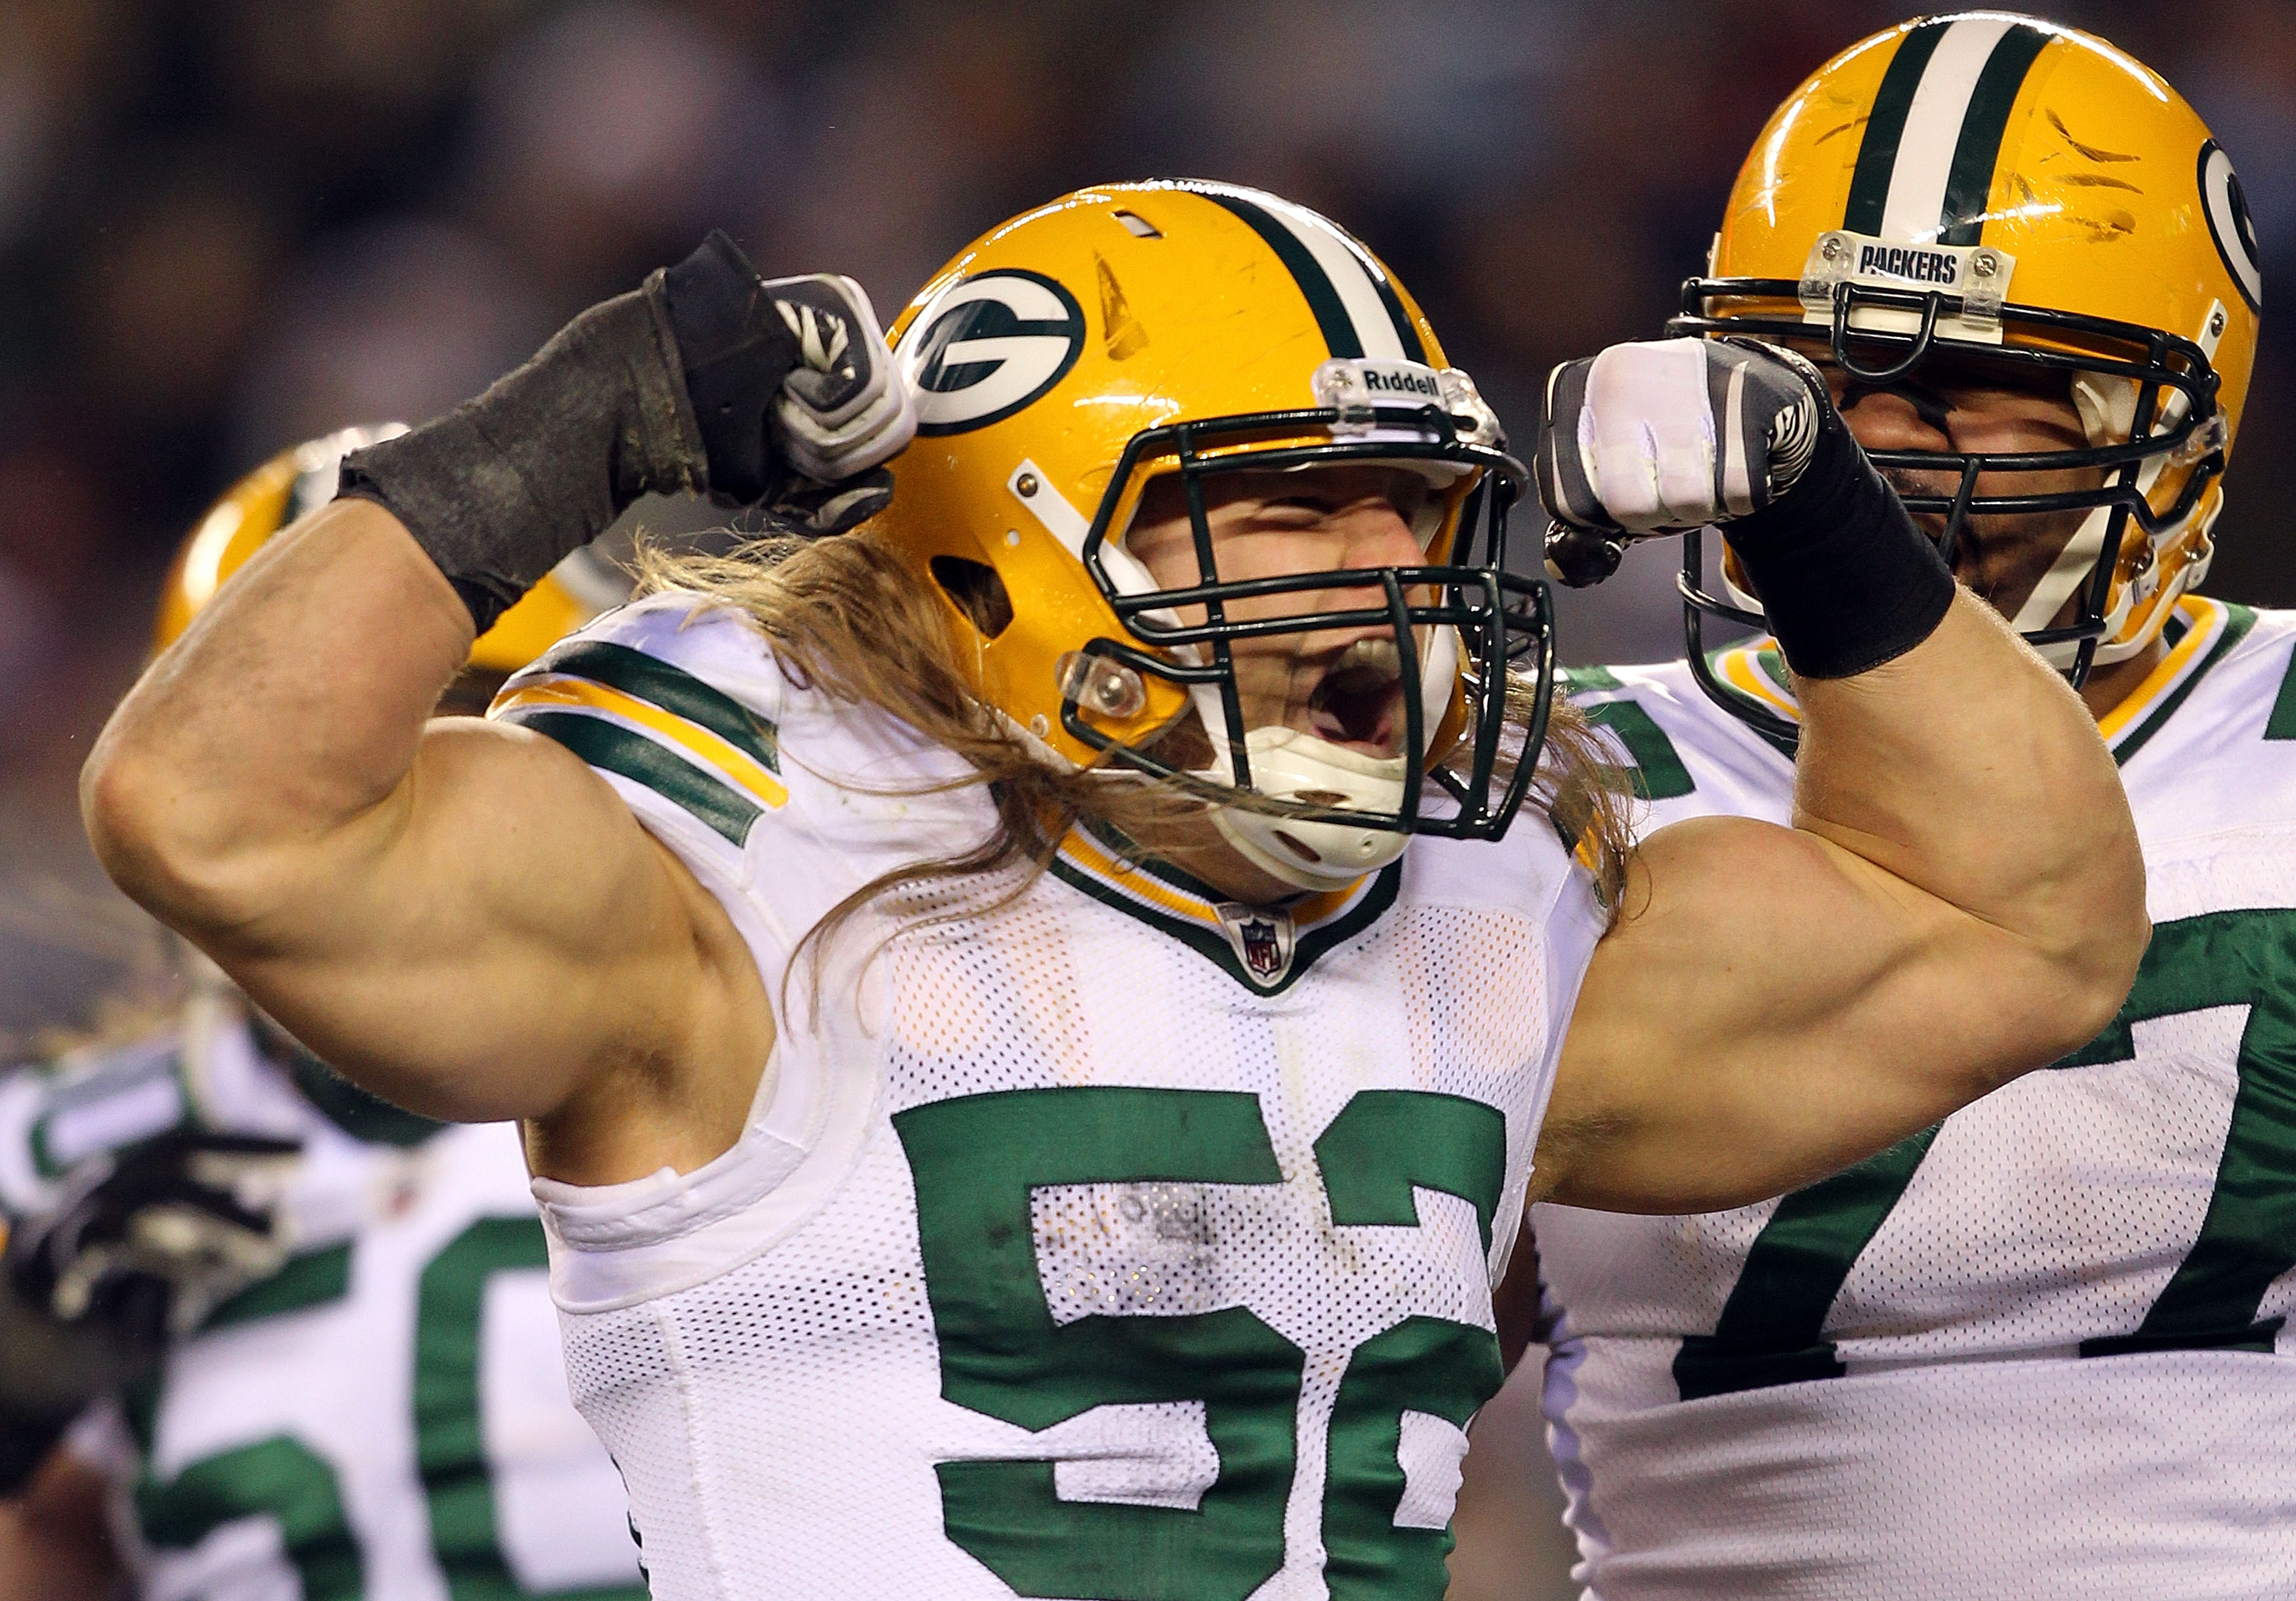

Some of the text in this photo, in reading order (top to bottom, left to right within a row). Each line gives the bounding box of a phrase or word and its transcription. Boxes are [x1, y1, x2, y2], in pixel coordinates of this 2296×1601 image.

[1860, 245, 1957, 283] PACKERS
[893, 276, 1072, 425] G
[1363, 370, 1439, 396] Riddell
[890, 1085, 1507, 1601] 52
